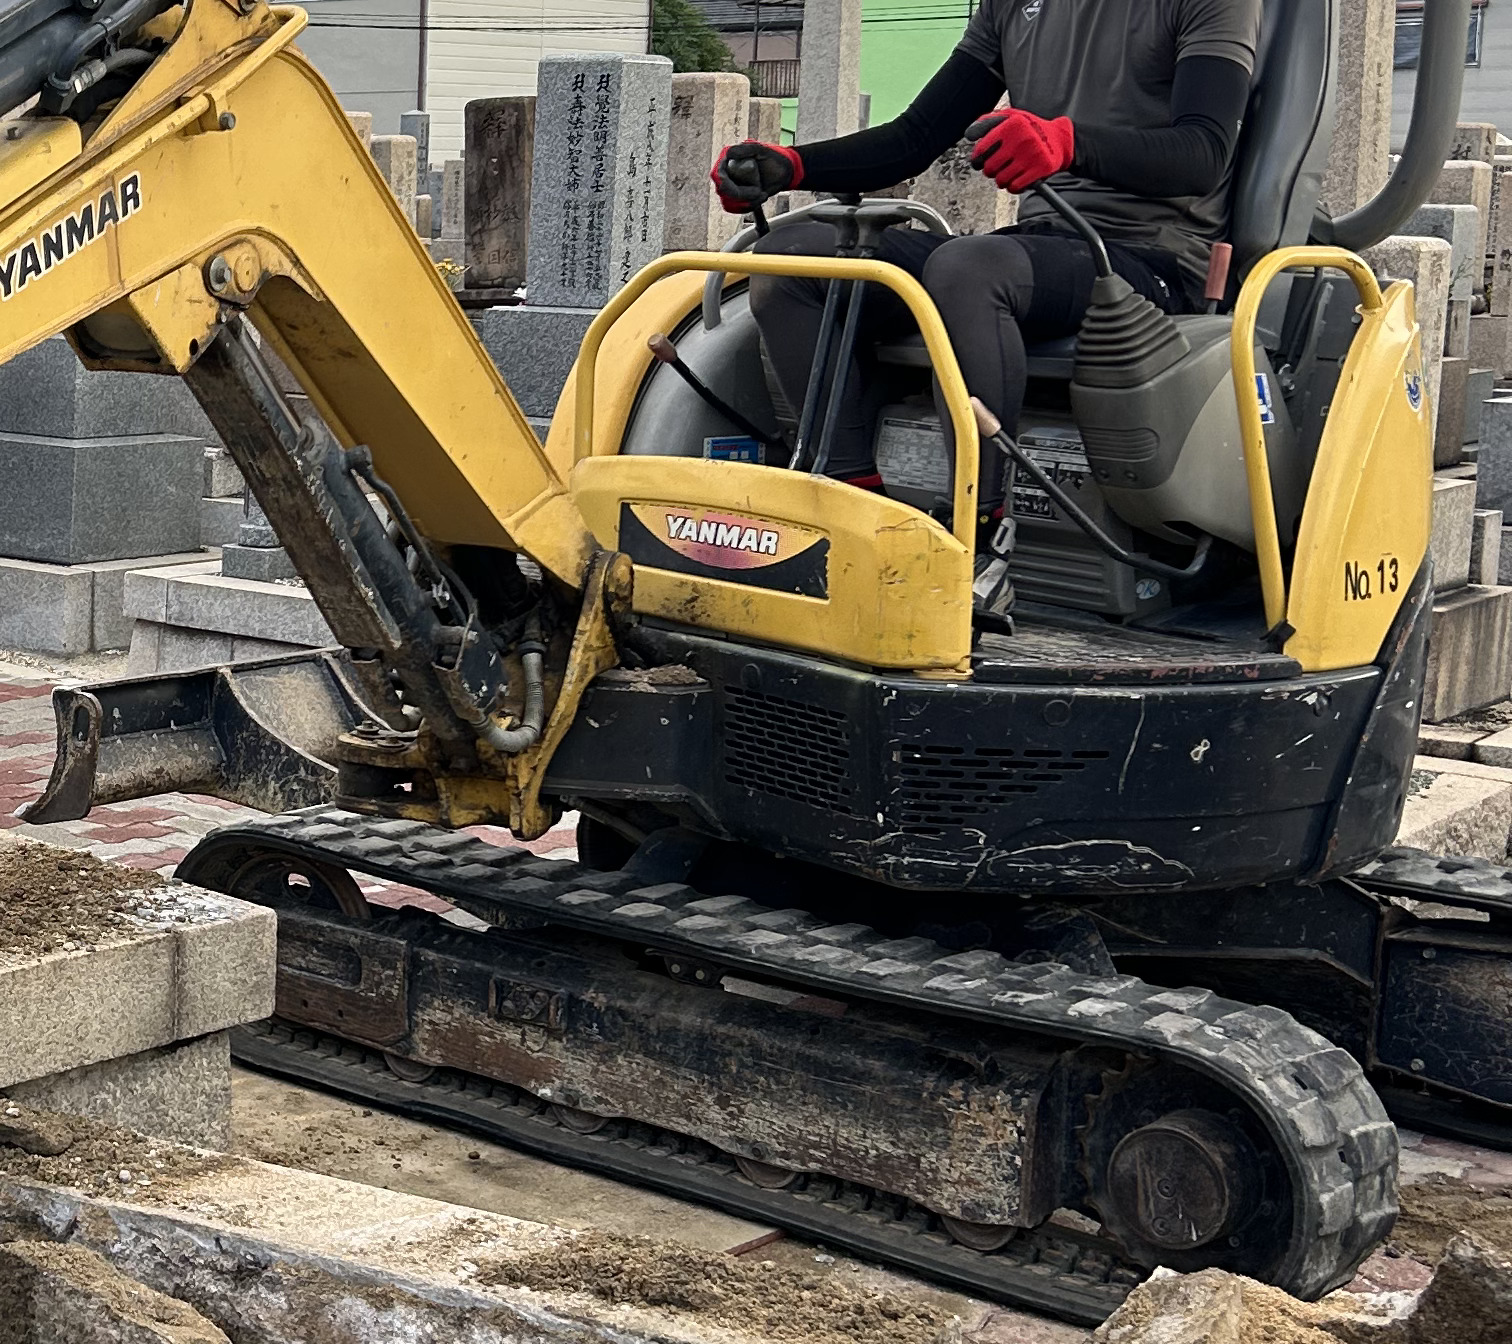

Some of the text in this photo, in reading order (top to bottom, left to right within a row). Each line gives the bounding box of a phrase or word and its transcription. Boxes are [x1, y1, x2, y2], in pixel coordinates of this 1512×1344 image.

[665, 513, 780, 555] YANMAR
[1344, 557, 1399, 601] No. 13
